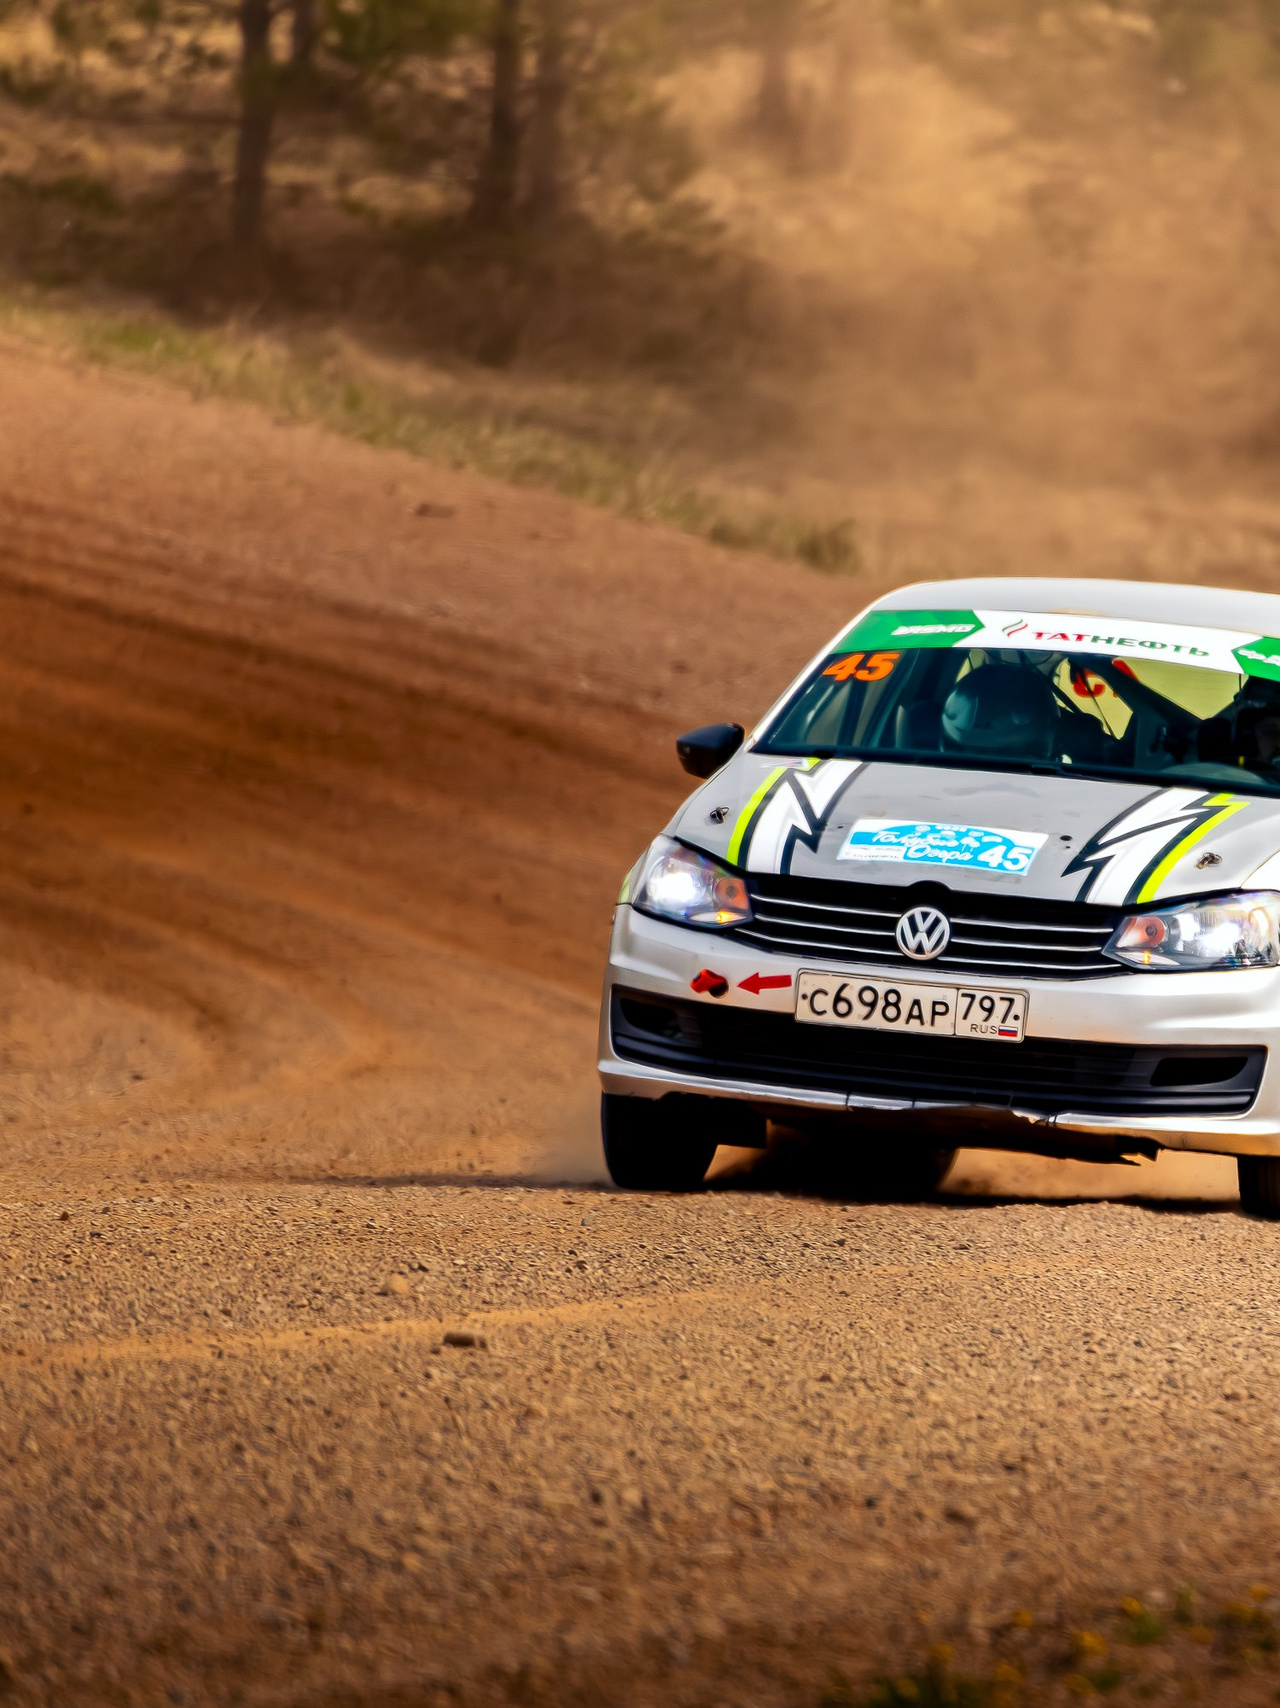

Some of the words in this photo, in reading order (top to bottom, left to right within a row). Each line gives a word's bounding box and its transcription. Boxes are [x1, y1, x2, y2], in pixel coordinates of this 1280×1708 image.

[1032, 631, 1210, 657] ТАТНЕФТЬ
[822, 653, 900, 682] 45
[977, 845, 1033, 871] 45
[898, 907, 949, 960] VW
[809, 982, 950, 1027] С698АР
[960, 992, 1016, 1024] 797
[970, 1023, 998, 1036] RUS
